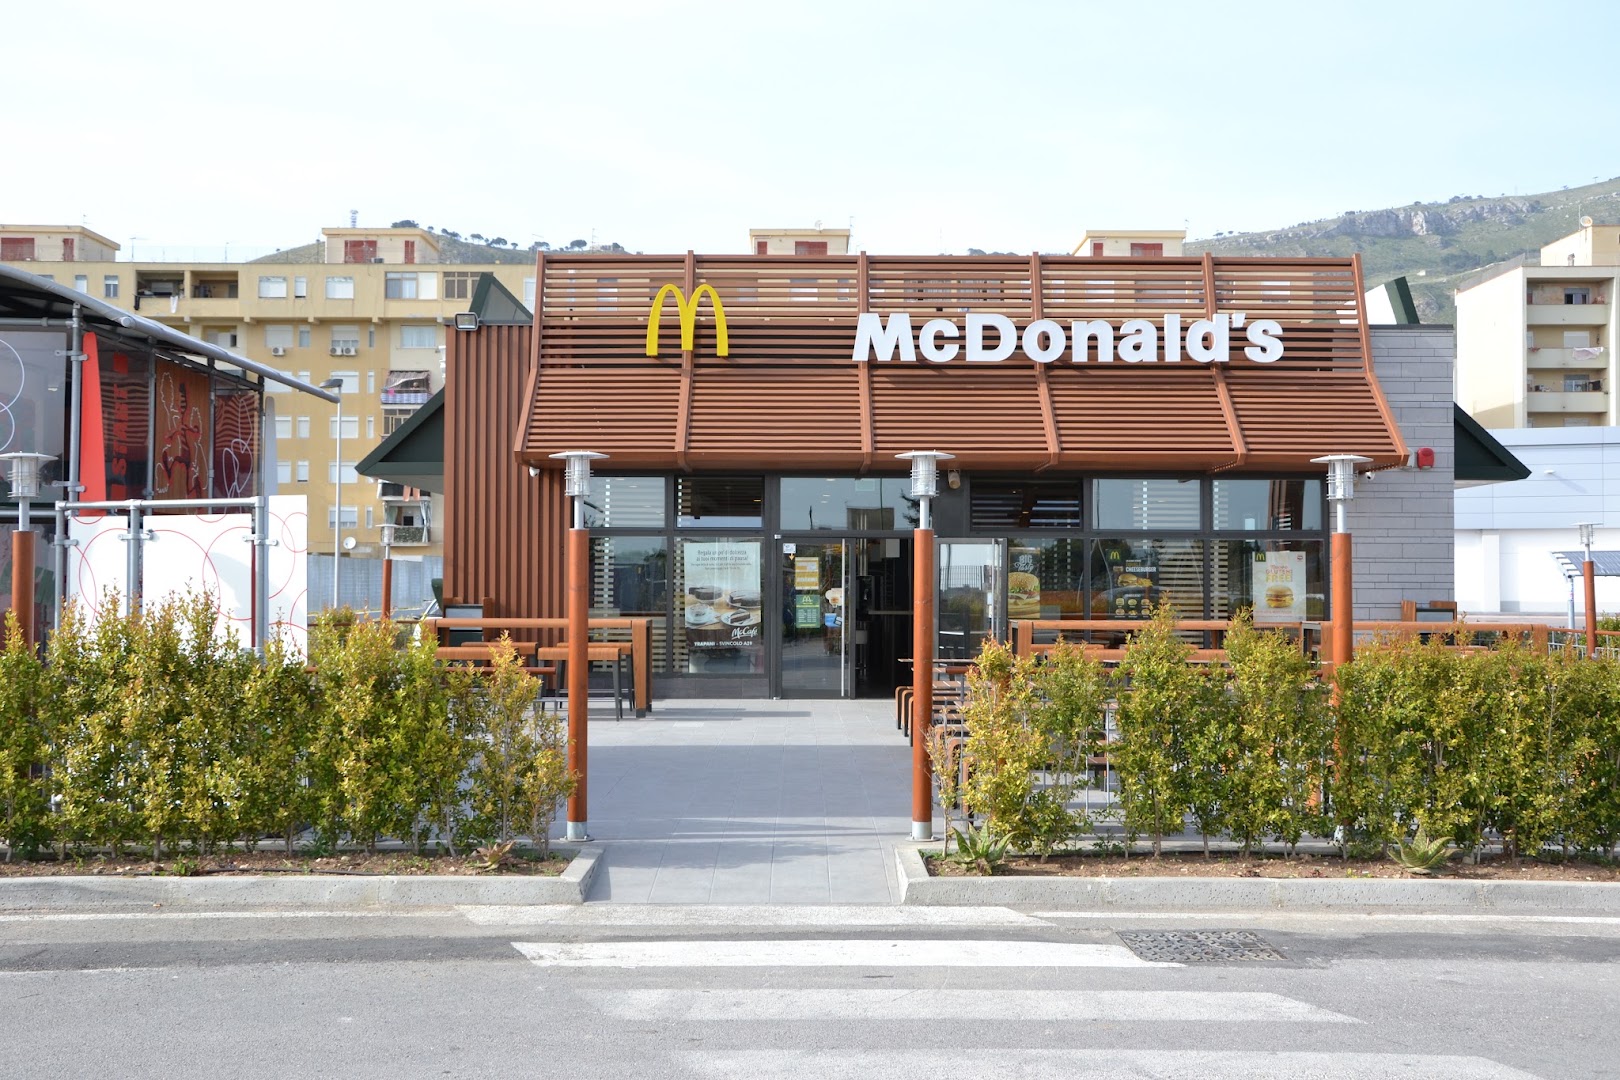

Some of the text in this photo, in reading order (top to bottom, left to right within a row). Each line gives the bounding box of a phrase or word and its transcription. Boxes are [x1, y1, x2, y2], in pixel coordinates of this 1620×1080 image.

[852, 312, 1284, 363] McDonald's
[111, 384, 128, 476] START
[1019, 554, 1032, 564] BIG
[1014, 562, 1034, 573] Tasty
[731, 626, 759, 639] McCafé
